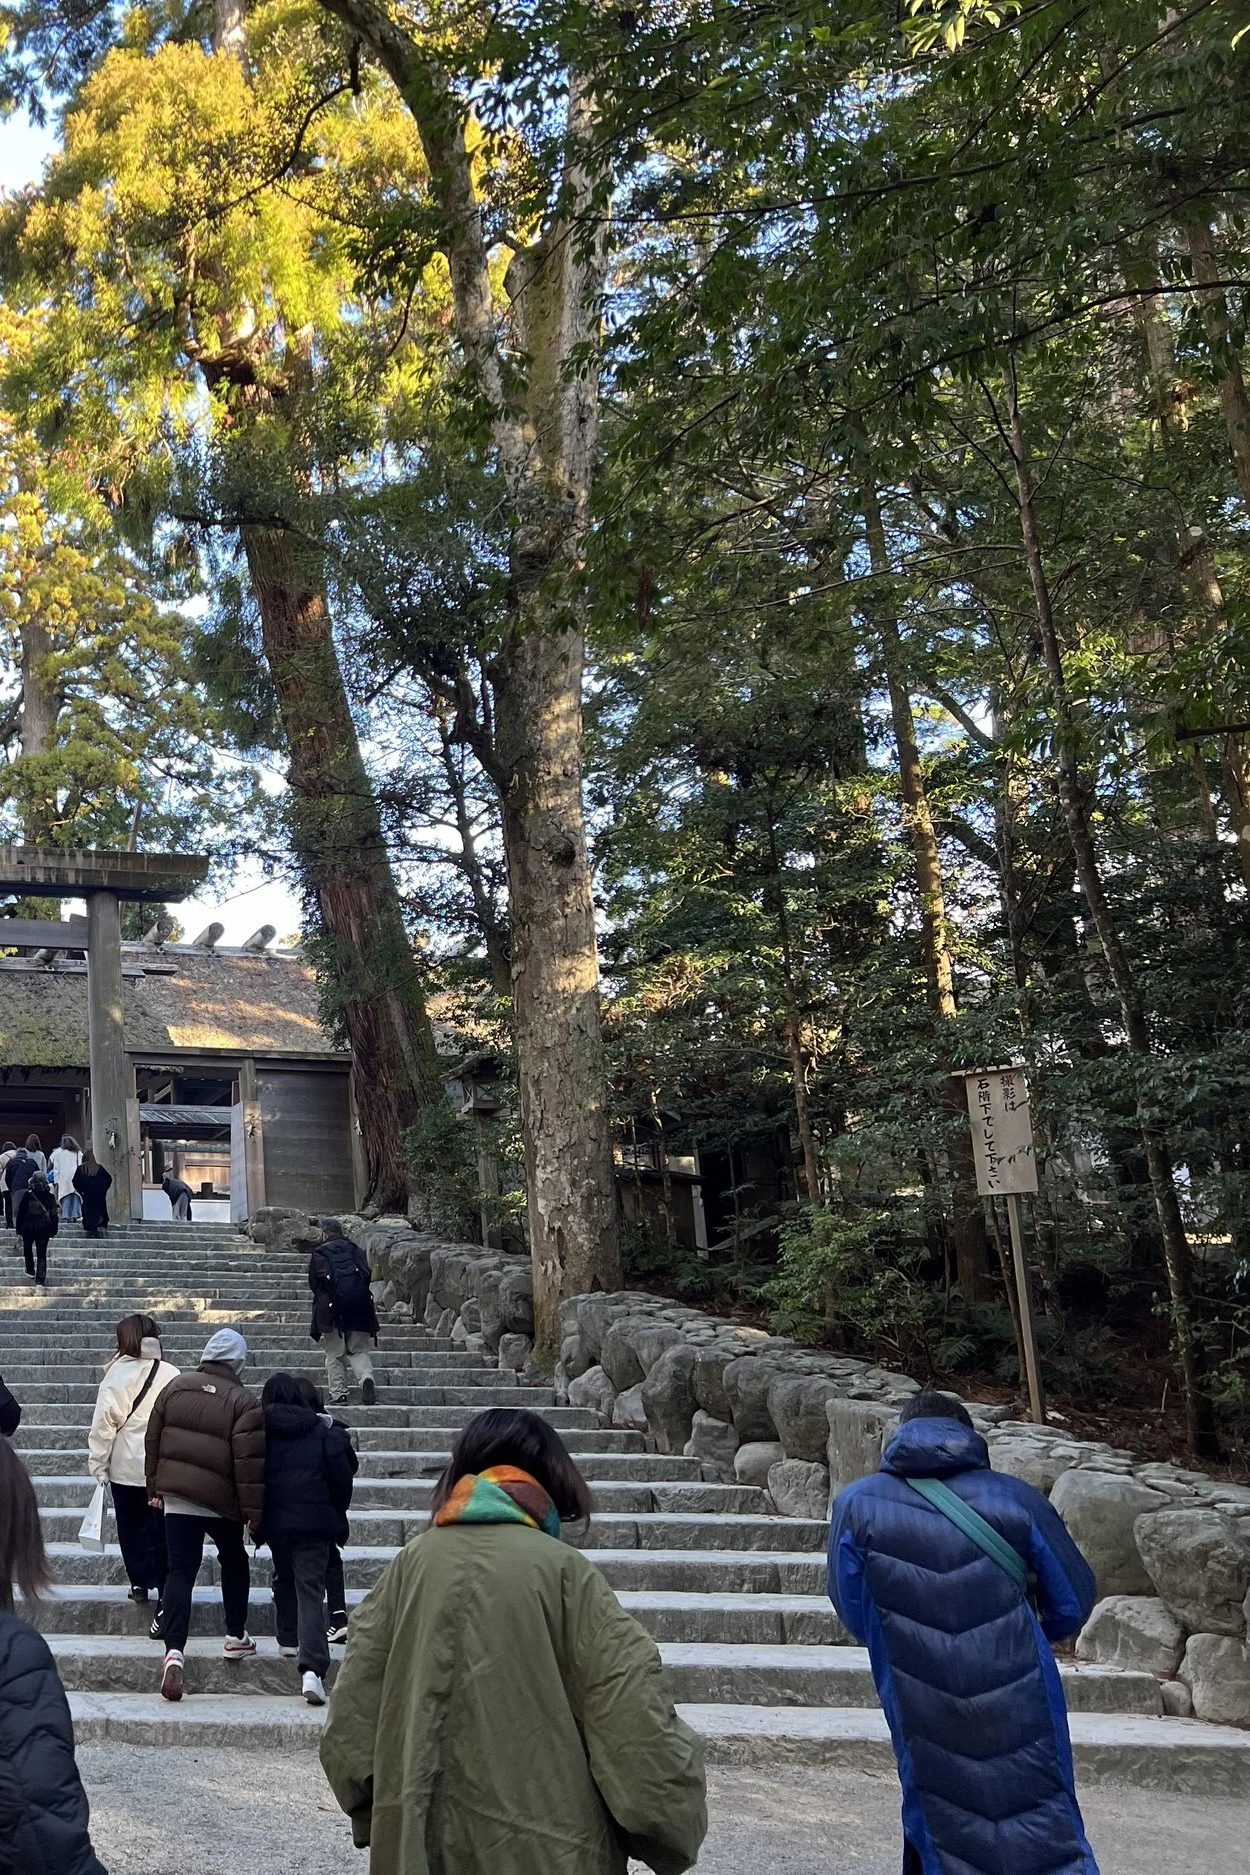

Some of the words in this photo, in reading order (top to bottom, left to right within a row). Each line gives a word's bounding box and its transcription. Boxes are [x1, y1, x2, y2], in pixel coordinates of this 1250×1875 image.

[999, 1075, 1016, 1113] 撮影は
[976, 1078, 1001, 1189] 石階下でして下さい
